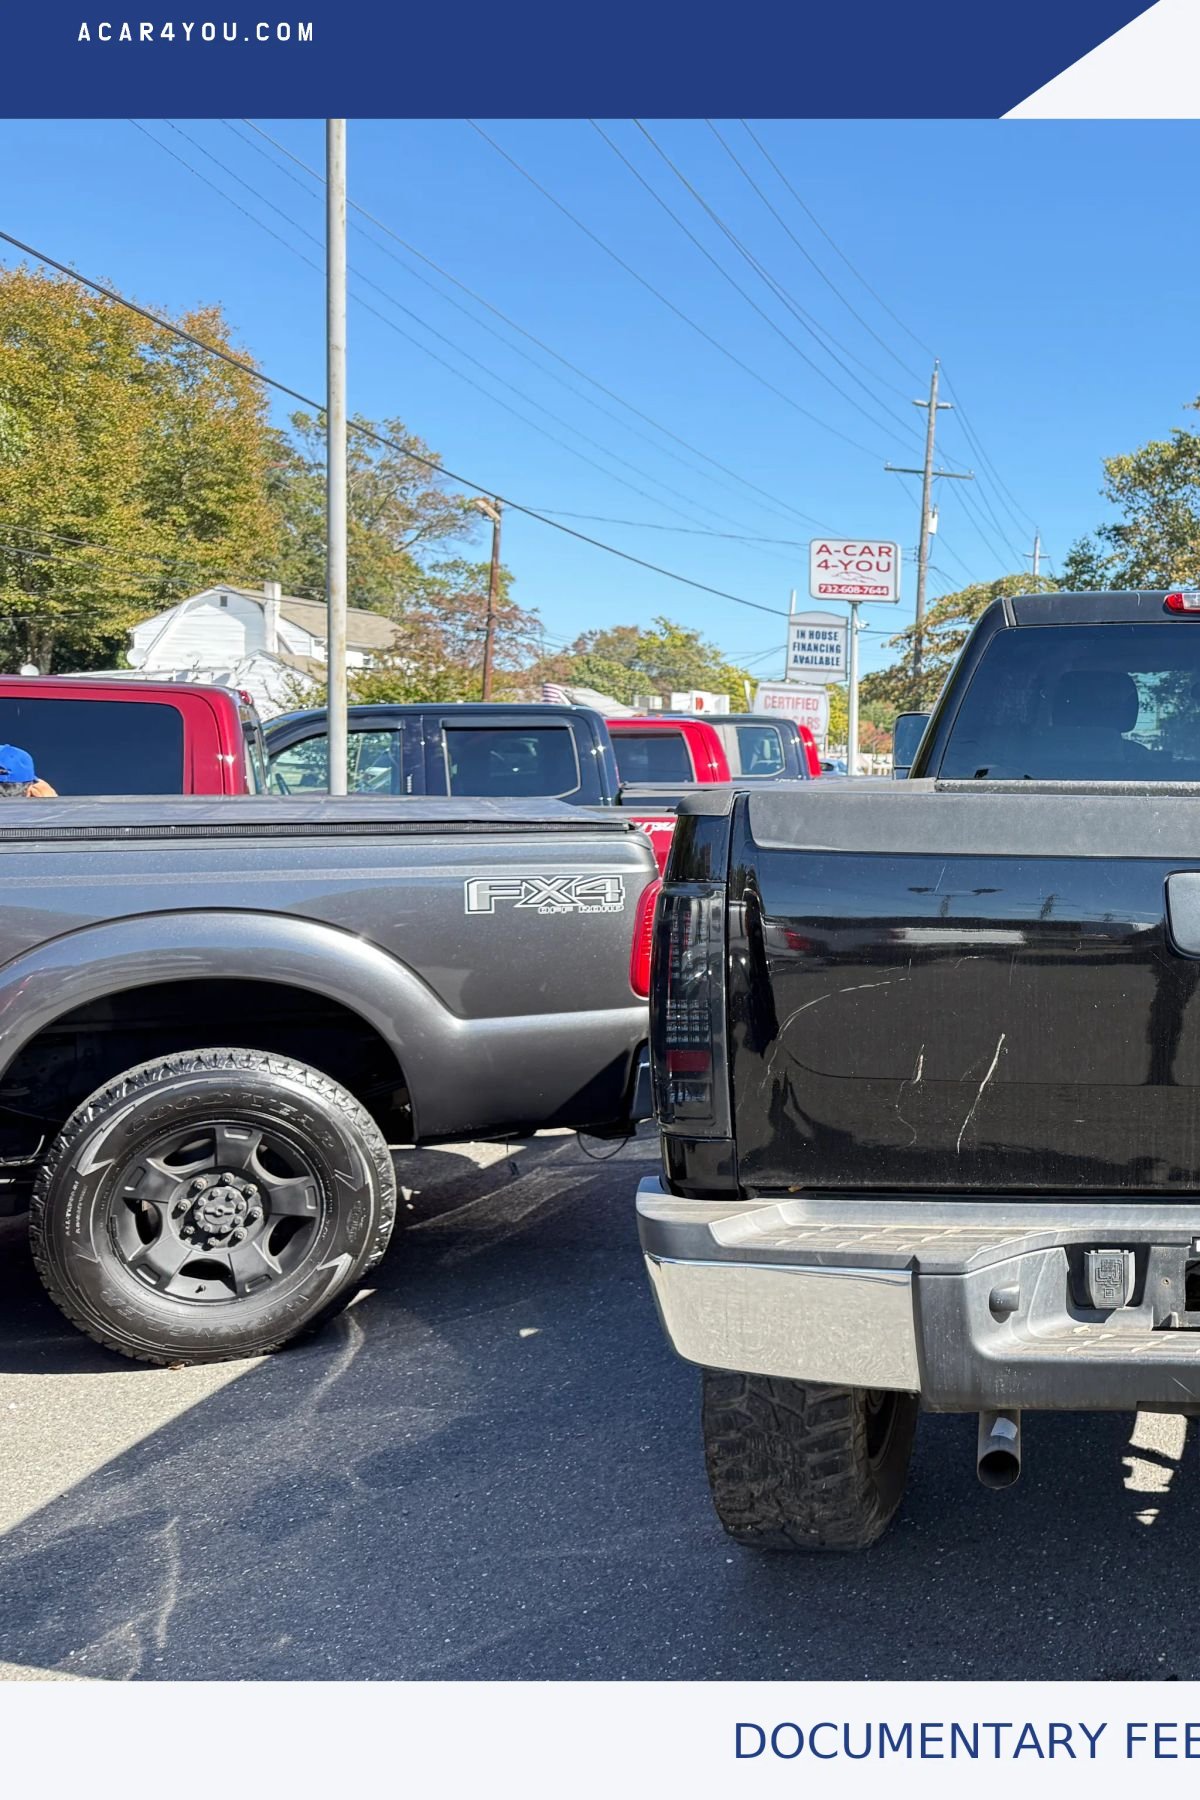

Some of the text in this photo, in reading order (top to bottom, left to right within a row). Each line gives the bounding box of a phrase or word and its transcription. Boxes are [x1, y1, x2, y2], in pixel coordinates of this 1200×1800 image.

[816, 544, 892, 557] A-CAR
[816, 559, 891, 572] 4-YOU
[796, 629, 839, 641] IN HOUSE
[792, 641, 842, 654] FINANCING
[793, 654, 841, 666] AVAILABLE
[764, 695, 819, 711] CERTIFIED
[465, 875, 626, 914] FX4
